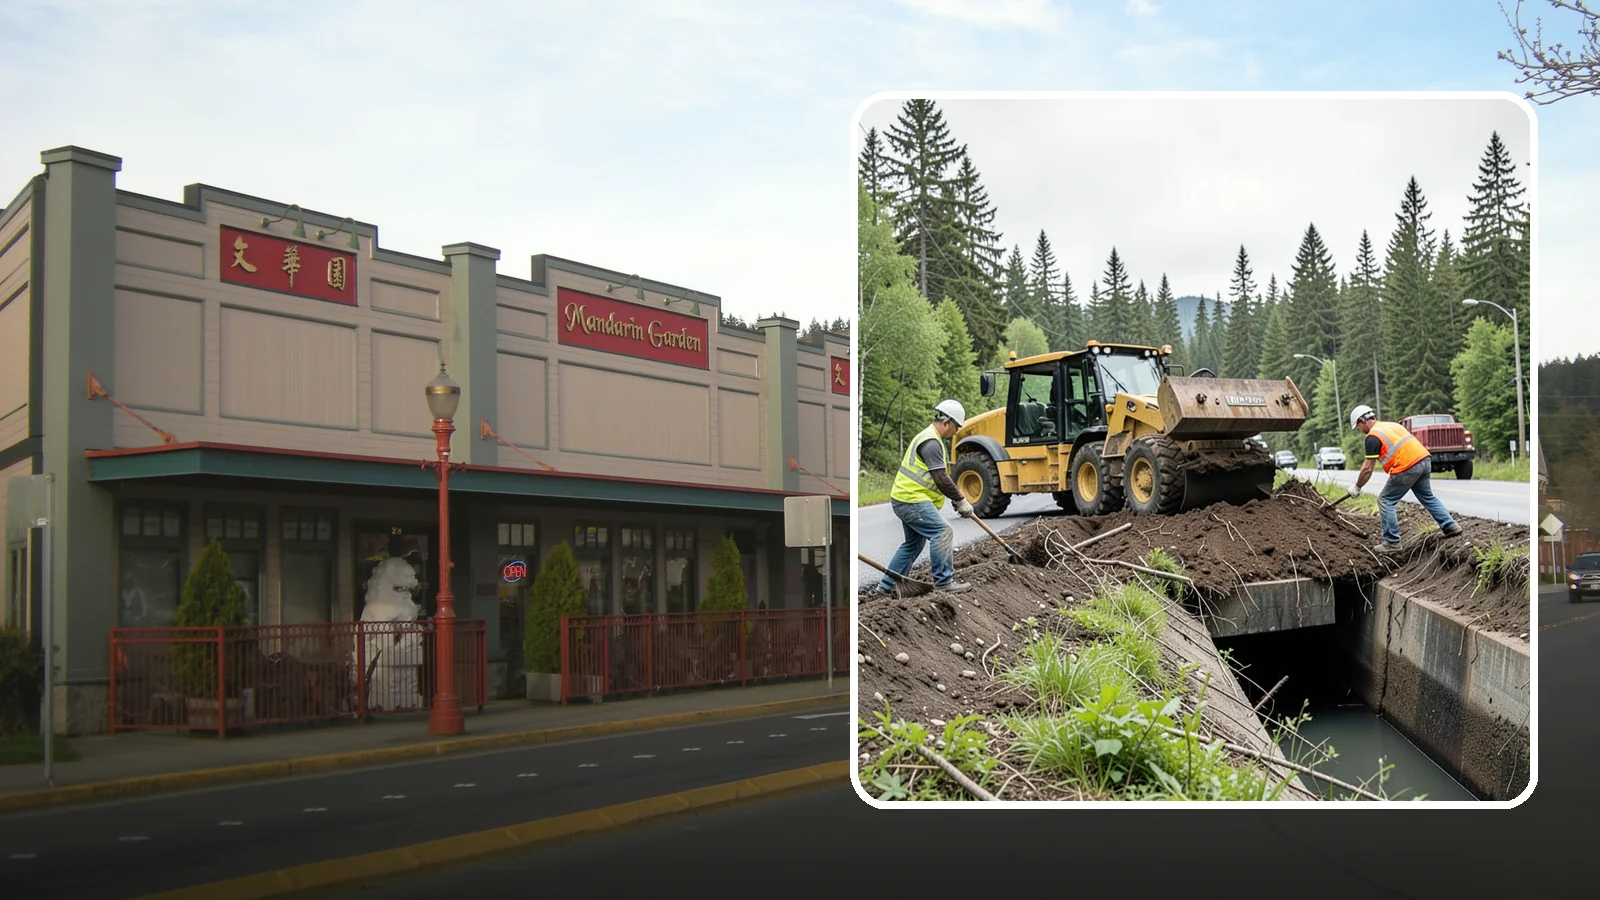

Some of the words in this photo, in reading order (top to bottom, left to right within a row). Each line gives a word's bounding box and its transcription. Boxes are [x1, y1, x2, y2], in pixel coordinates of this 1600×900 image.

[231, 235, 346, 291] 文華園
[564, 302, 644, 341] Mandarin
[647, 320, 702, 352] Garden
[503, 565, 527, 578] OPEN
